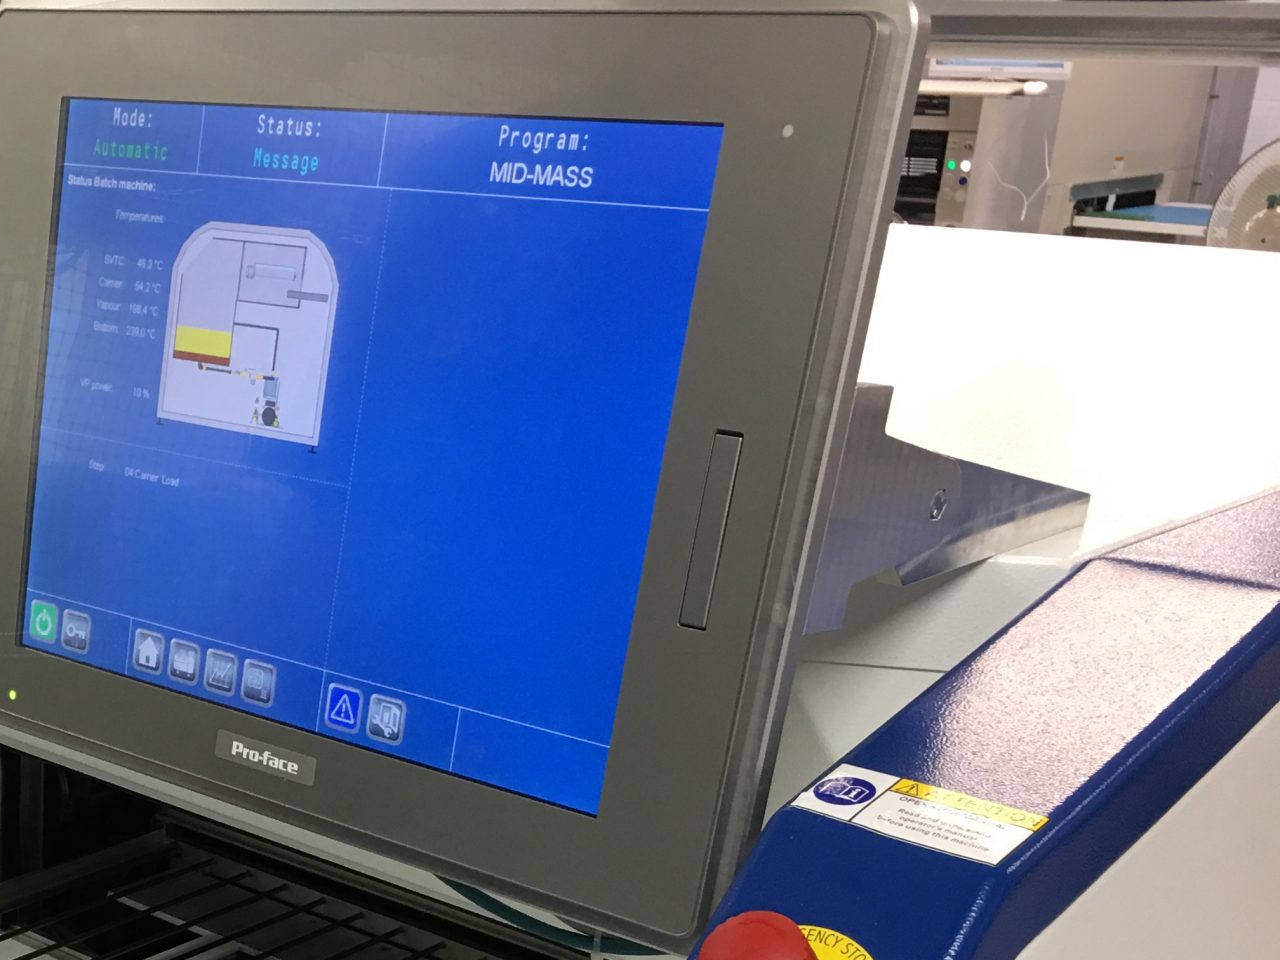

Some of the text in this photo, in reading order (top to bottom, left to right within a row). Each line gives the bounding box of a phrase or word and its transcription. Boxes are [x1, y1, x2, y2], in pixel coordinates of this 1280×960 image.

[112, 107, 153, 128] Mode:
[257, 113, 321, 138] Status:
[93, 138, 168, 161] Automatic
[498, 124, 588, 153] Program:
[253, 147, 319, 175] Message
[68, 174, 92, 186] Status
[489, 161, 593, 188] MID-MASS
[231, 740, 299, 776] Pro-face
